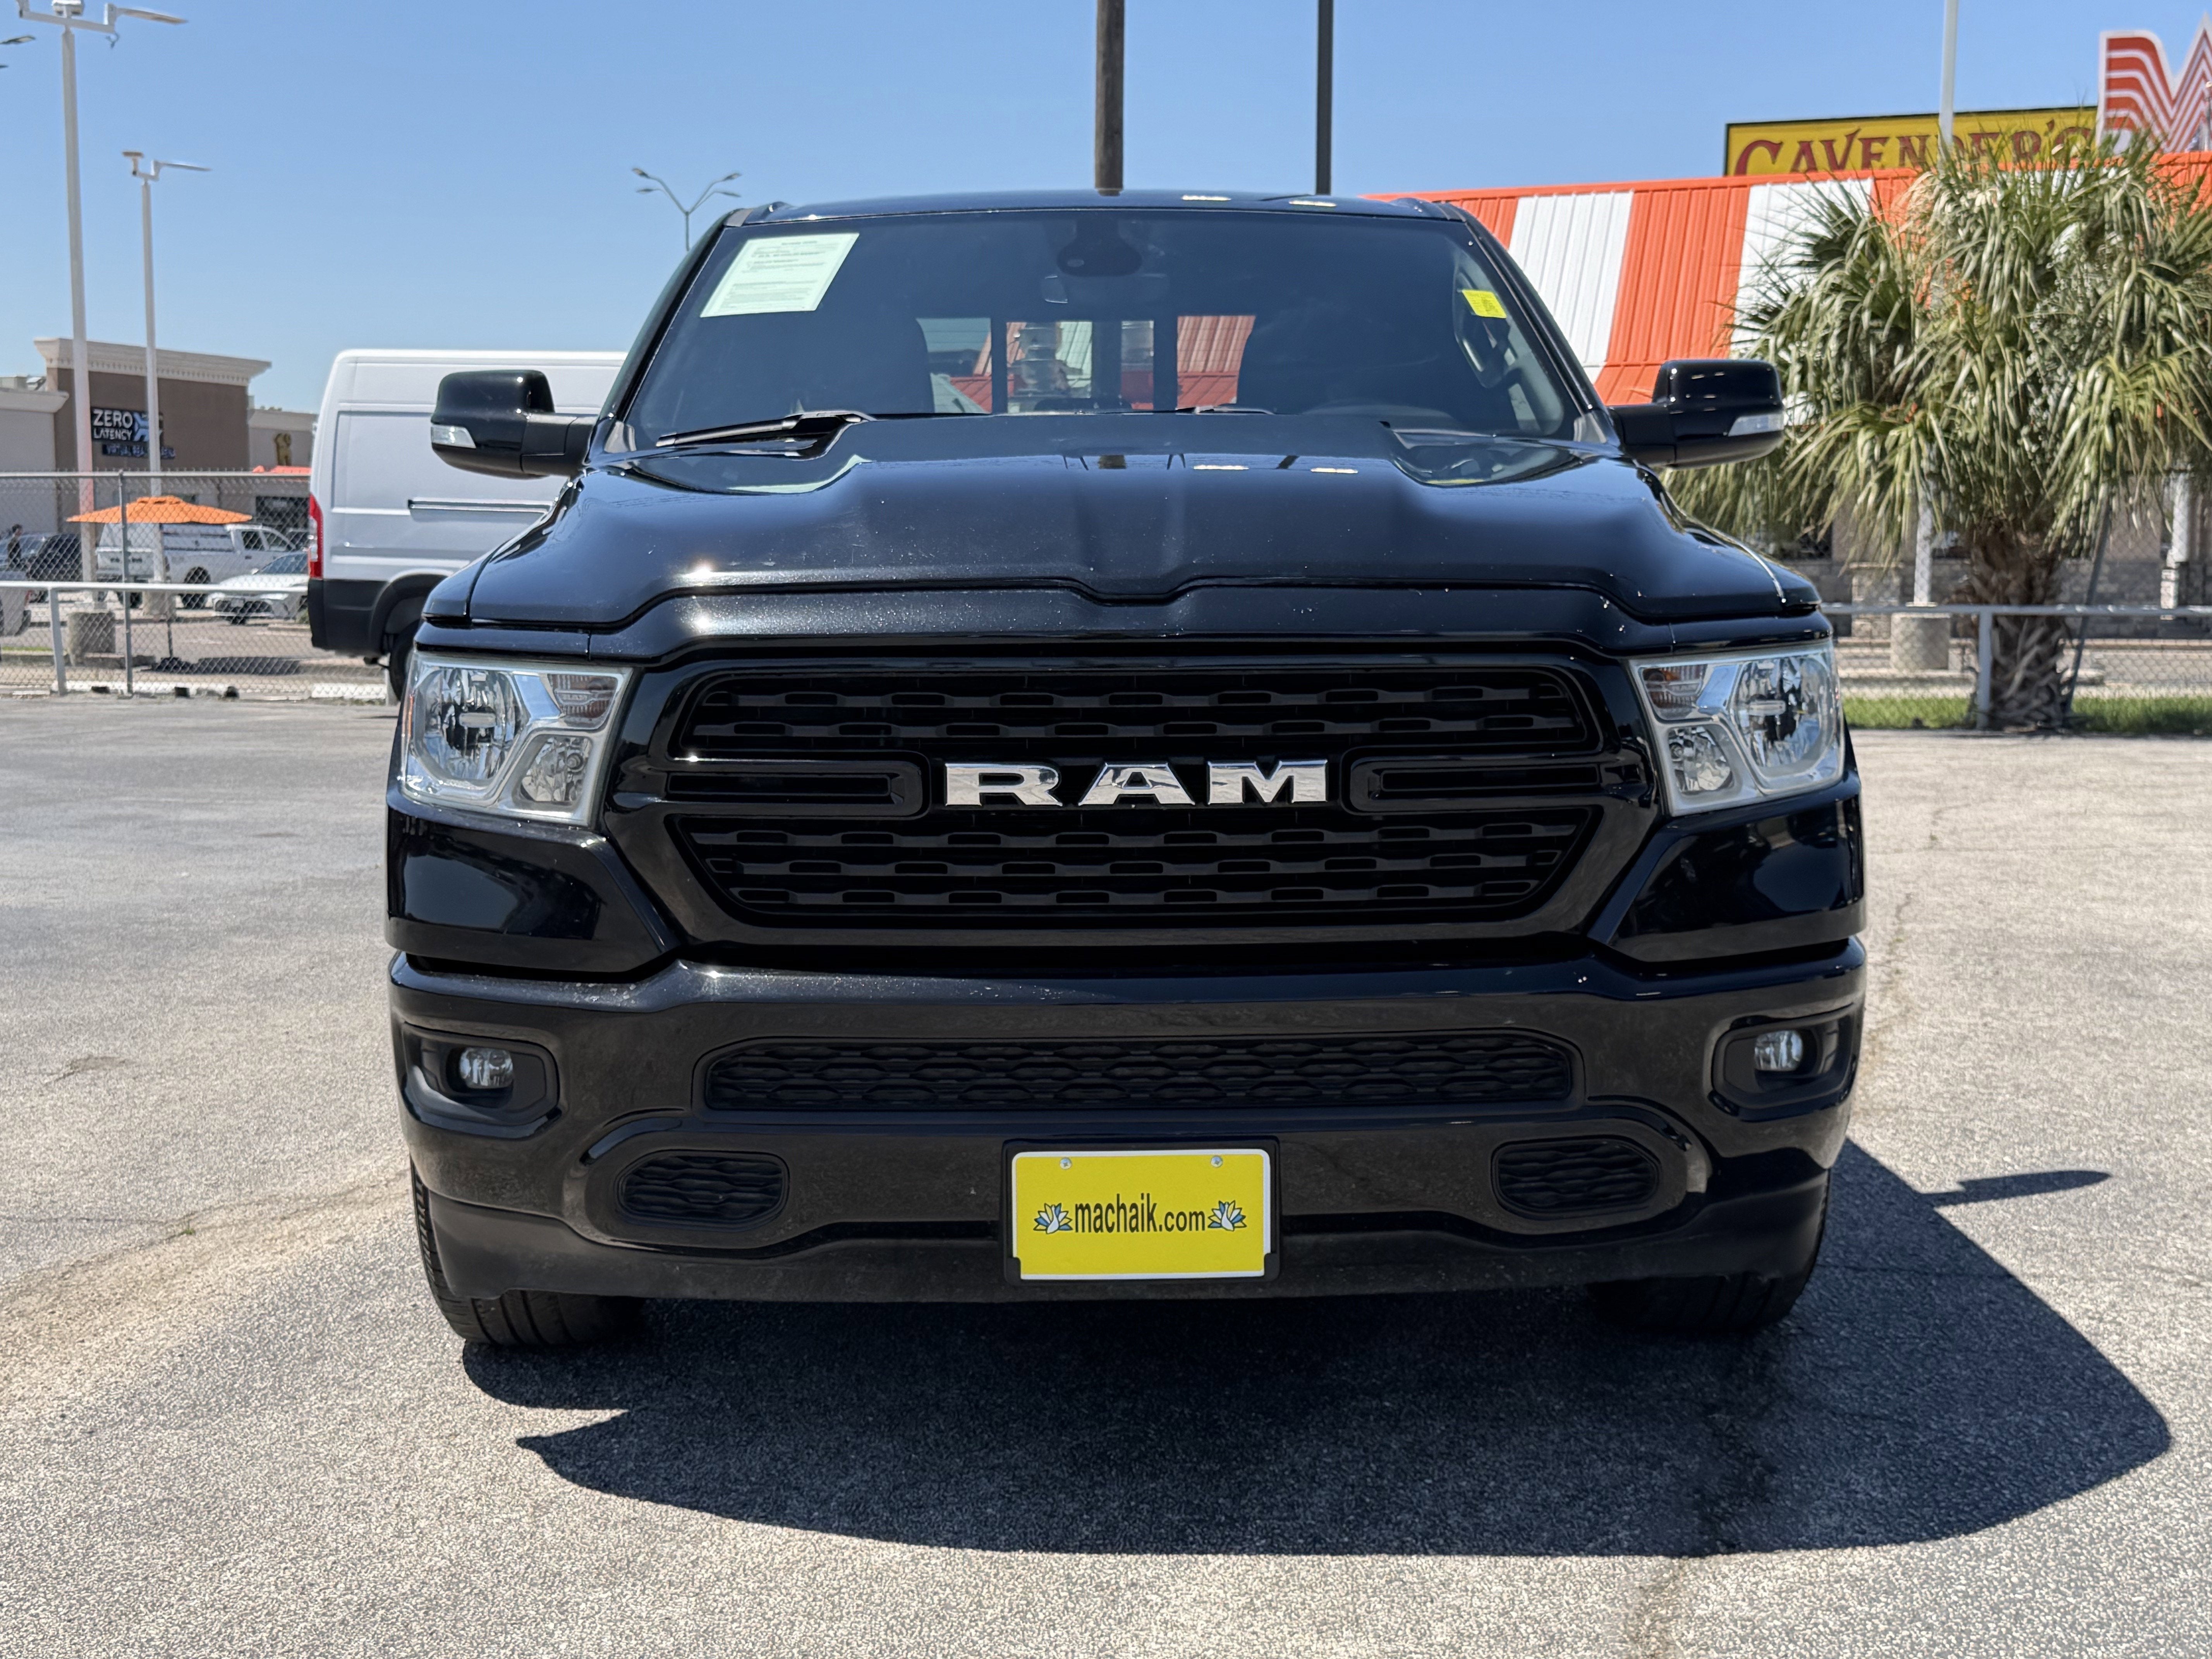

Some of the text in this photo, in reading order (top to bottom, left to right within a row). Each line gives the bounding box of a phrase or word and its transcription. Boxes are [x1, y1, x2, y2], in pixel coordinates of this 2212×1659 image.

[93, 409, 133, 428] ZERO
[93, 428, 132, 440] LATENCY
[945, 759, 1328, 806] RAM
[1075, 1193, 1205, 1233] machaik.com
